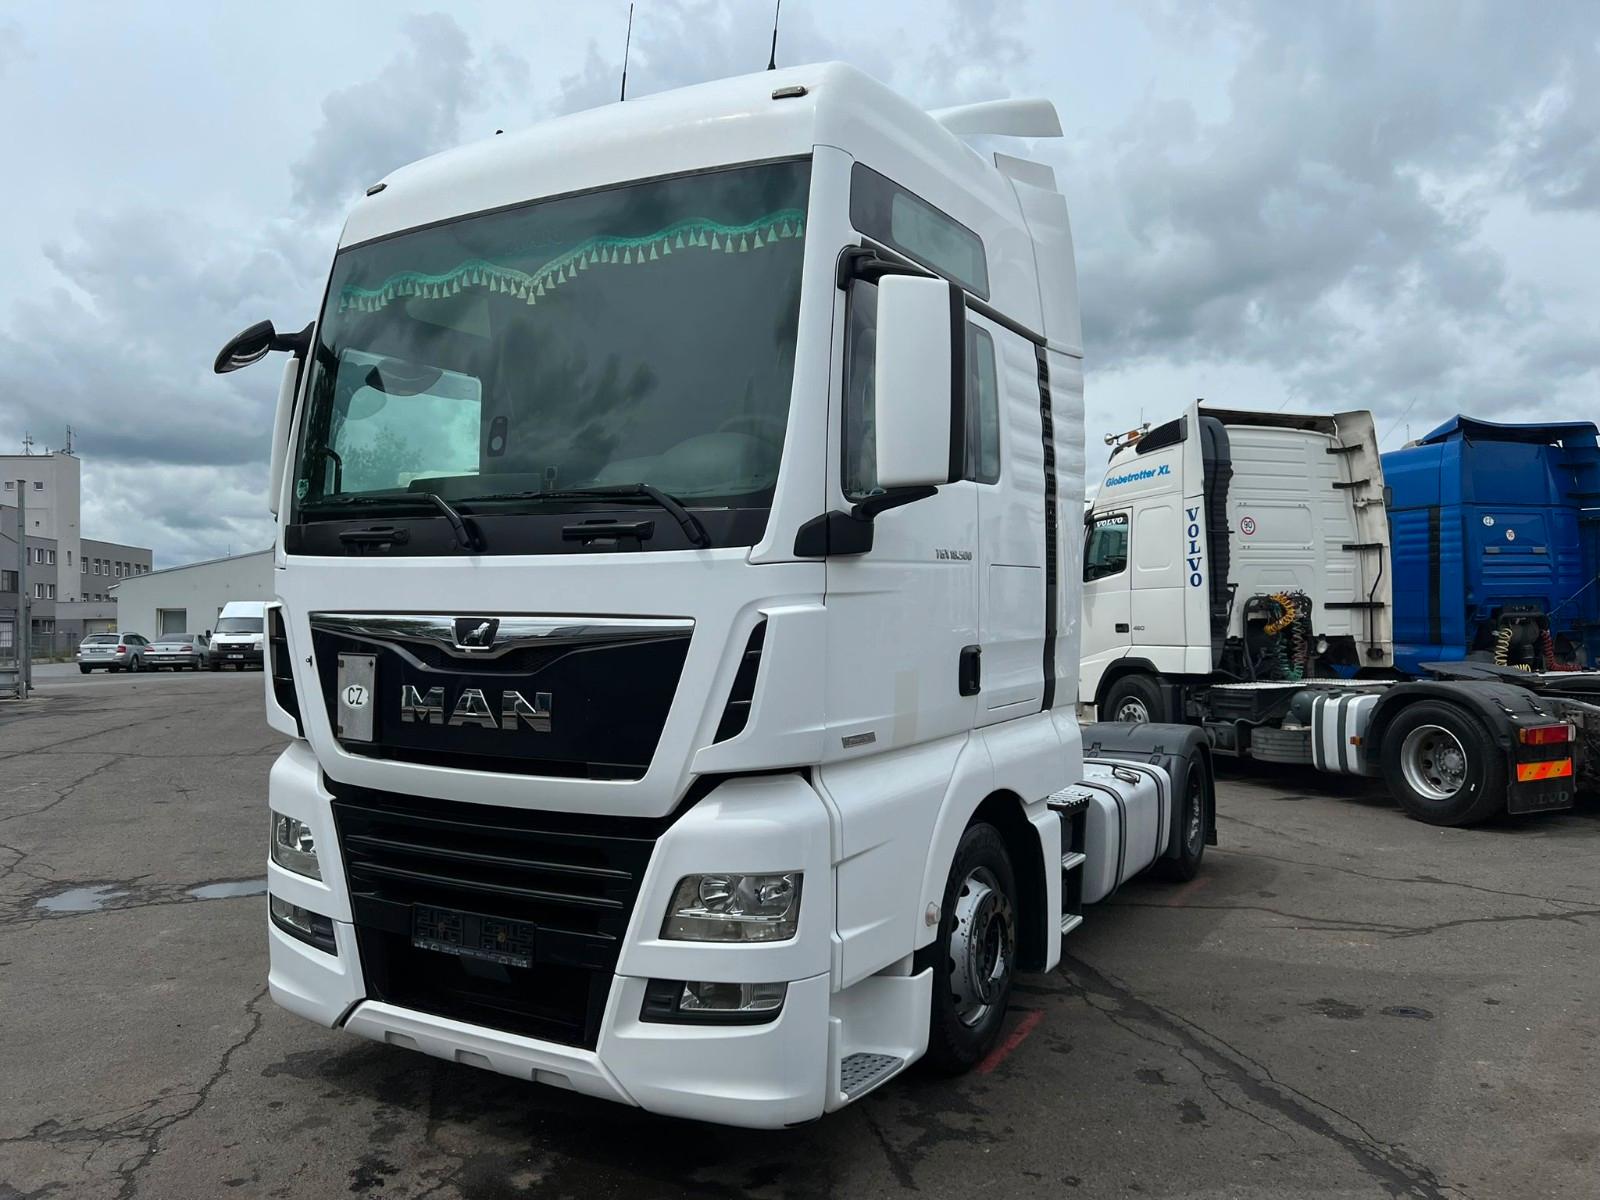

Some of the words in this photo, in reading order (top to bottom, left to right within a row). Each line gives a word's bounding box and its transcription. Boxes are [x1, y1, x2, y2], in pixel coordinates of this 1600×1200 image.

[1105, 469, 1156, 487] Globetrotter
[1158, 465, 1171, 476] XL
[1096, 517, 1123, 528] VOLVO
[1185, 506, 1202, 587] VOLVO
[347, 687, 363, 705] CZ
[402, 685, 552, 732] MAN
